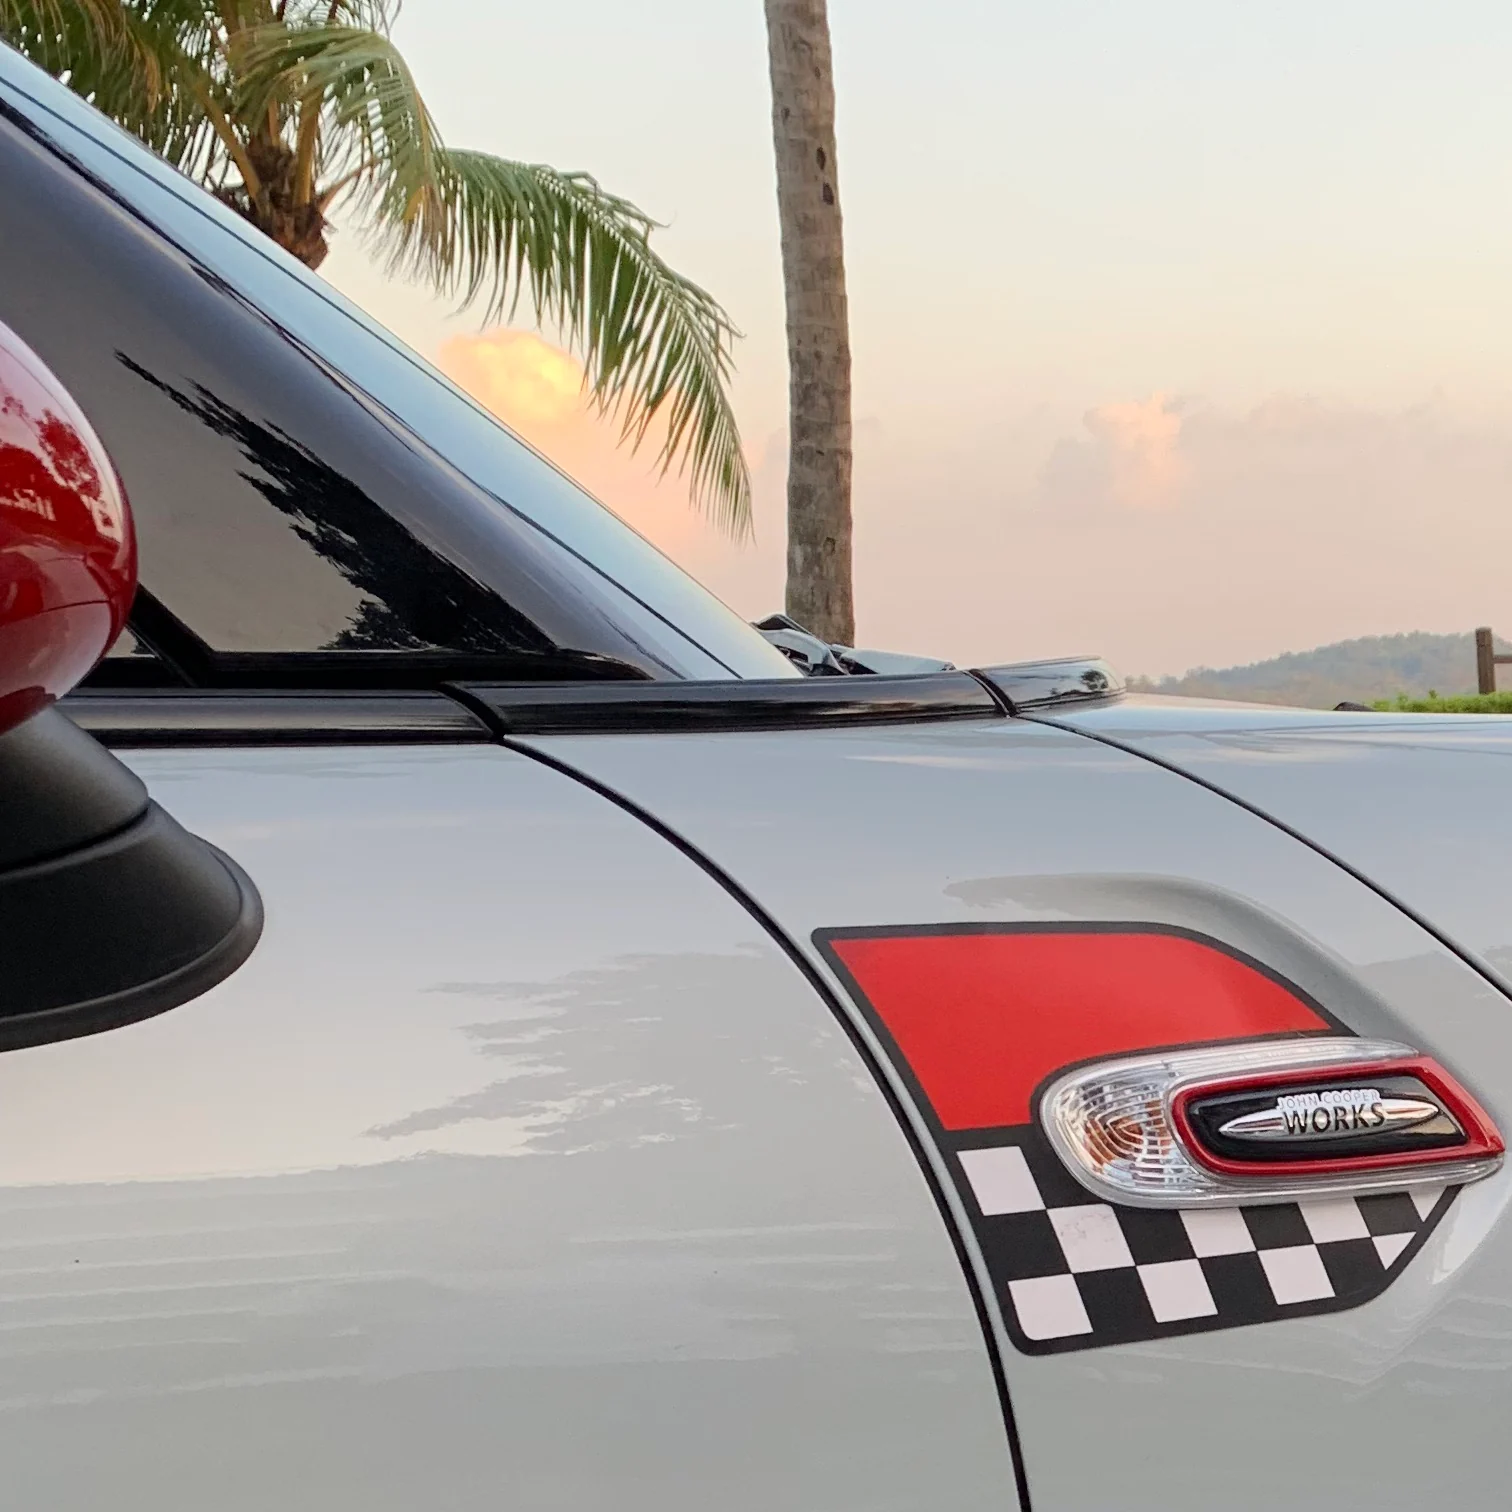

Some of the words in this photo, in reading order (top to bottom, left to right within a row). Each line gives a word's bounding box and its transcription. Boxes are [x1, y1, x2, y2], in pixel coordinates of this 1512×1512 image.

[1279, 1094, 1318, 1110] JOHN
[1322, 1090, 1379, 1104] COOPER
[1282, 1102, 1385, 1135] WORKS
